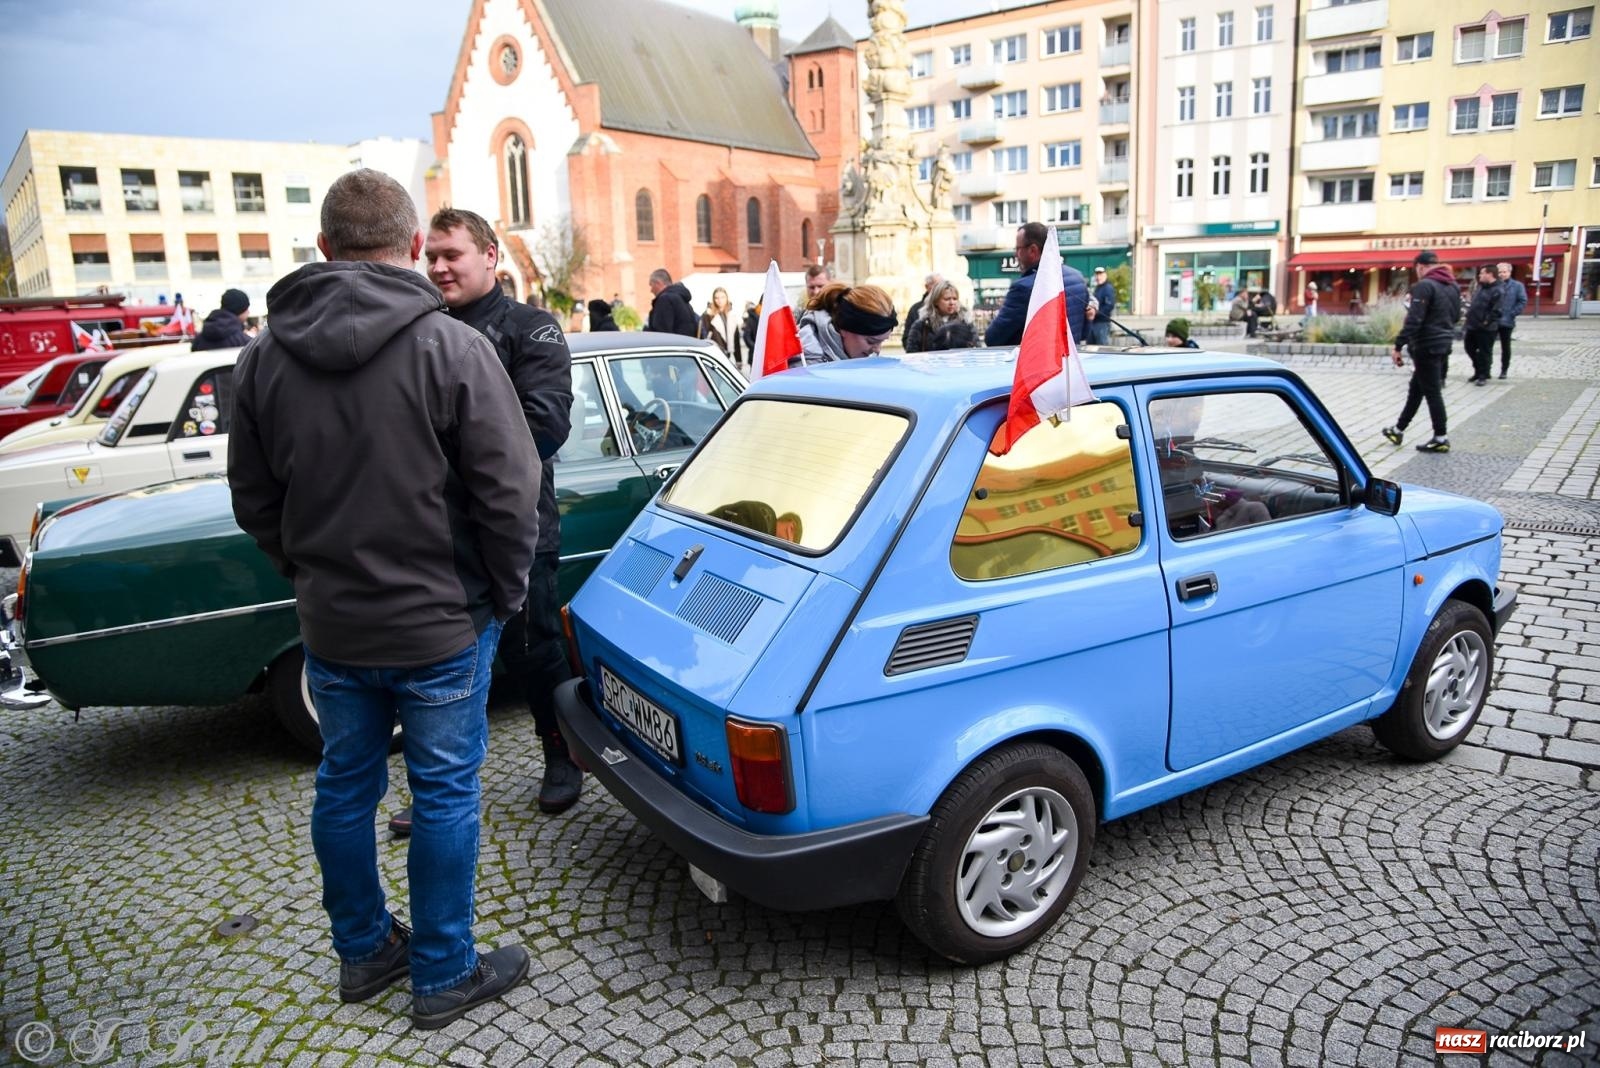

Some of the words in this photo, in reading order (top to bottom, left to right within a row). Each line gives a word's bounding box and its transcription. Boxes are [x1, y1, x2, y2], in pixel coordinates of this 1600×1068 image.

[1382, 236, 1472, 249] RESTAURACJA
[604, 672, 629, 717] SRC
[632, 694, 674, 751] WM86
